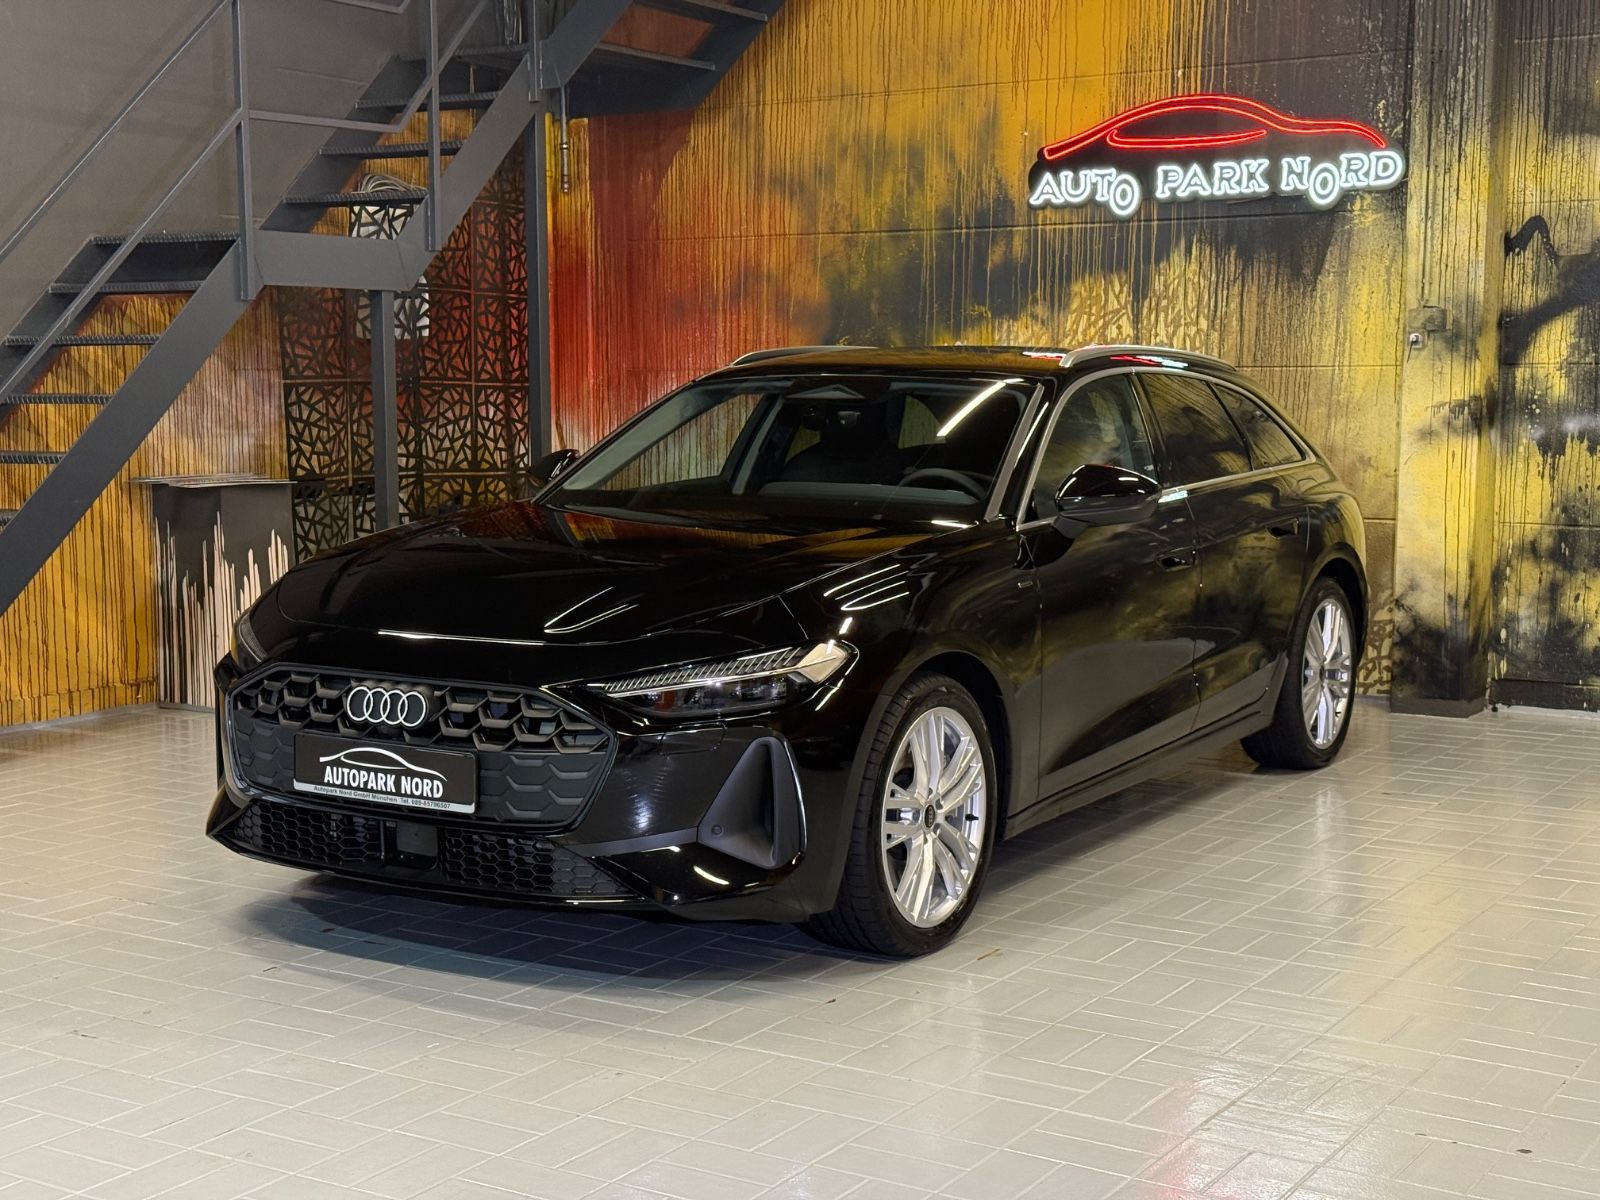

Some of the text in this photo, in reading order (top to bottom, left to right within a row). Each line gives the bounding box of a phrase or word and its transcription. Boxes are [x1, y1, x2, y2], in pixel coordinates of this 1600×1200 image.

[1029, 150, 1403, 217] AUTO PARK NORD
[314, 785, 337, 795] Autopark
[338, 789, 352, 797] Nord
[353, 791, 370, 799] GmbH
[371, 793, 398, 803] München
[400, 797, 411, 805] Tel.
[324, 766, 443, 798] AUTOPARK NORD
